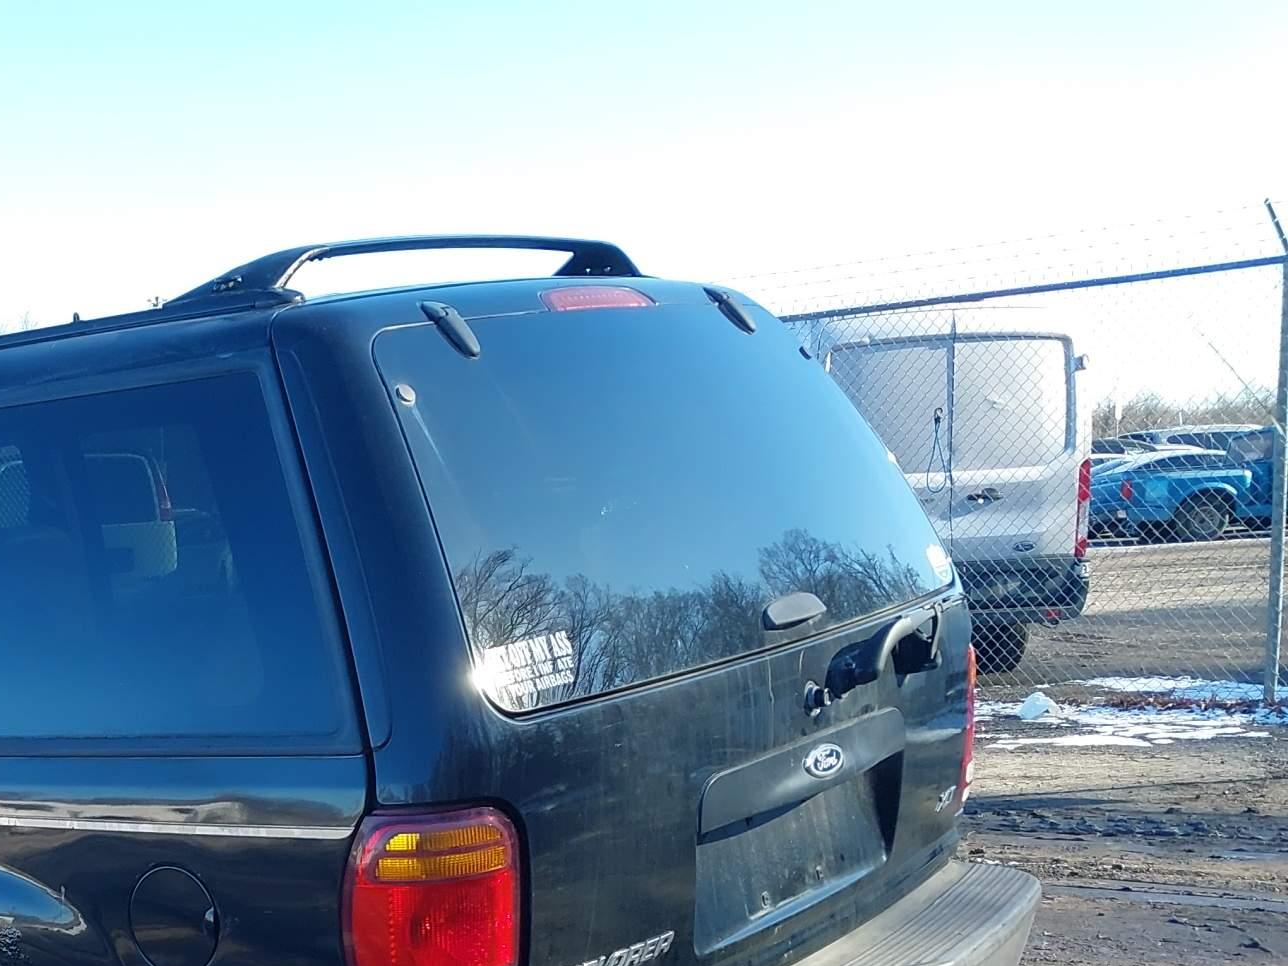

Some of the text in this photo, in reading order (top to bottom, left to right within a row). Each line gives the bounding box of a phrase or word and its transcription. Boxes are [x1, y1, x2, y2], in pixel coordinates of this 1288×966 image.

[529, 636, 551, 662] MY
[550, 630, 572, 657] ASS
[538, 656, 574, 675] INFATE
[508, 670, 574, 698] YOUR AIRBAGS
